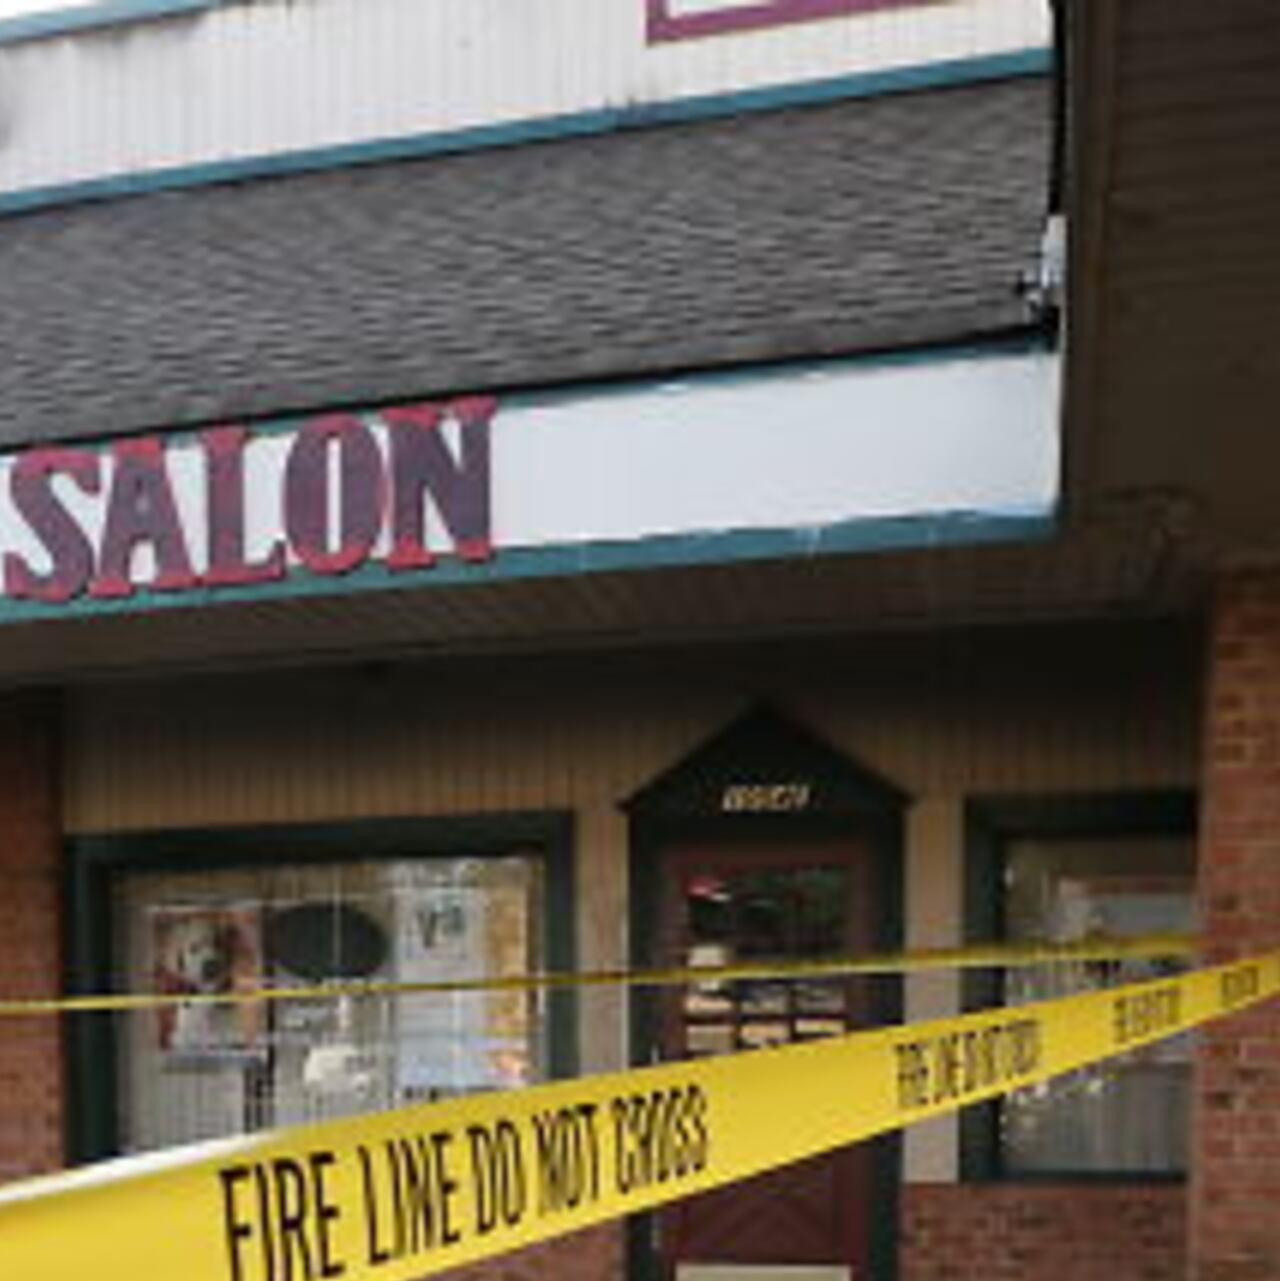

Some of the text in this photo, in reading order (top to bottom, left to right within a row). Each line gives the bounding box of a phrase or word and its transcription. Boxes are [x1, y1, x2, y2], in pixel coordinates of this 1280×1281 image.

[4, 396, 499, 600] SALON
[357, 1132, 461, 1266] LINE
[467, 1120, 527, 1235] DO
[532, 1103, 600, 1217] NOT
[610, 1084, 708, 1194] CROSS
